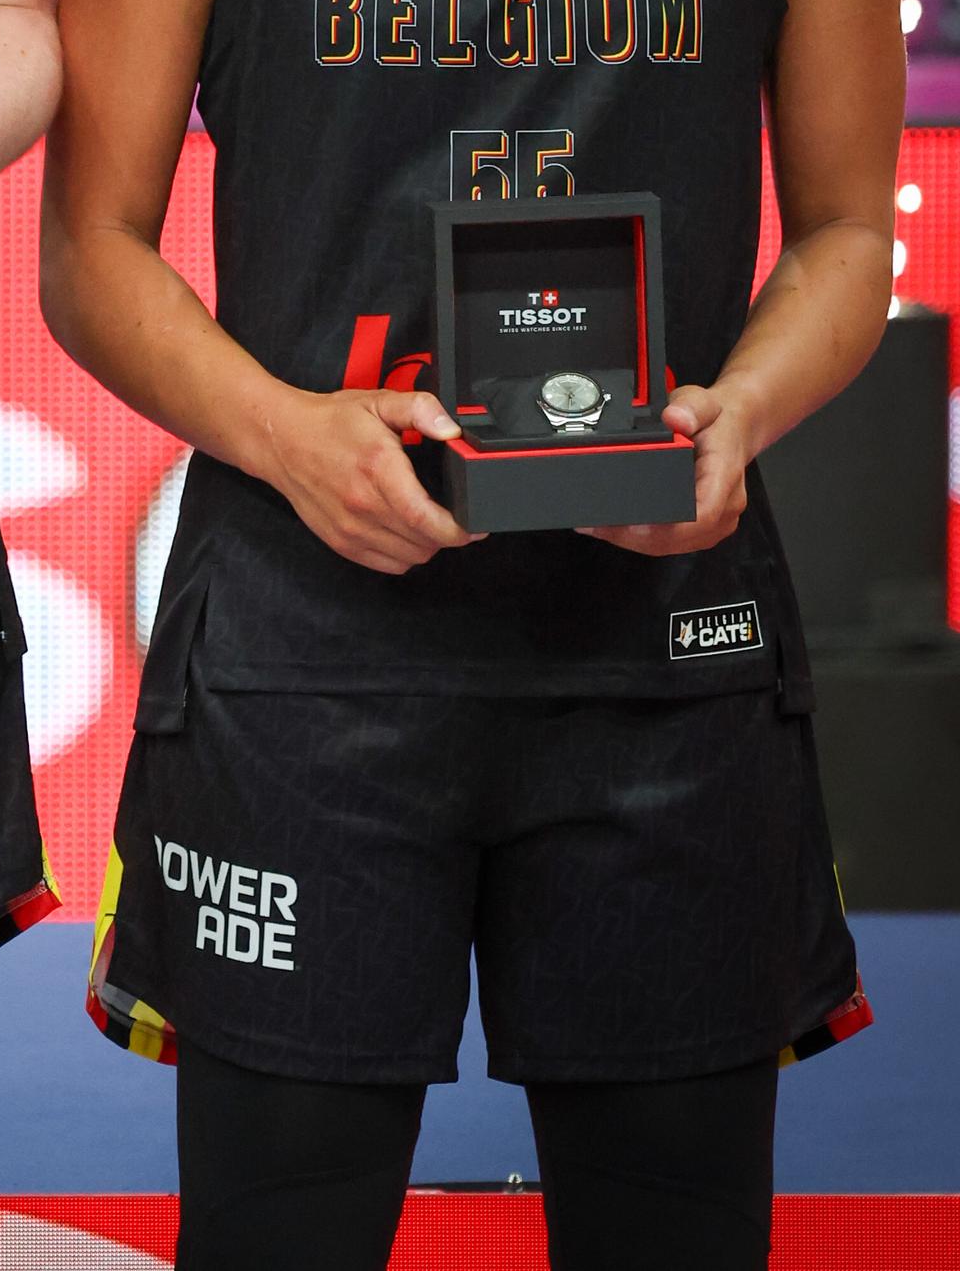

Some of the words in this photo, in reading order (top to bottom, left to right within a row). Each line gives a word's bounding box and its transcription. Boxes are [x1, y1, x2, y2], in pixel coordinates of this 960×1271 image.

[499, 308, 586, 325] TISSOT
[699, 622, 753, 648] CATS
[196, 905, 296, 971] ADE
